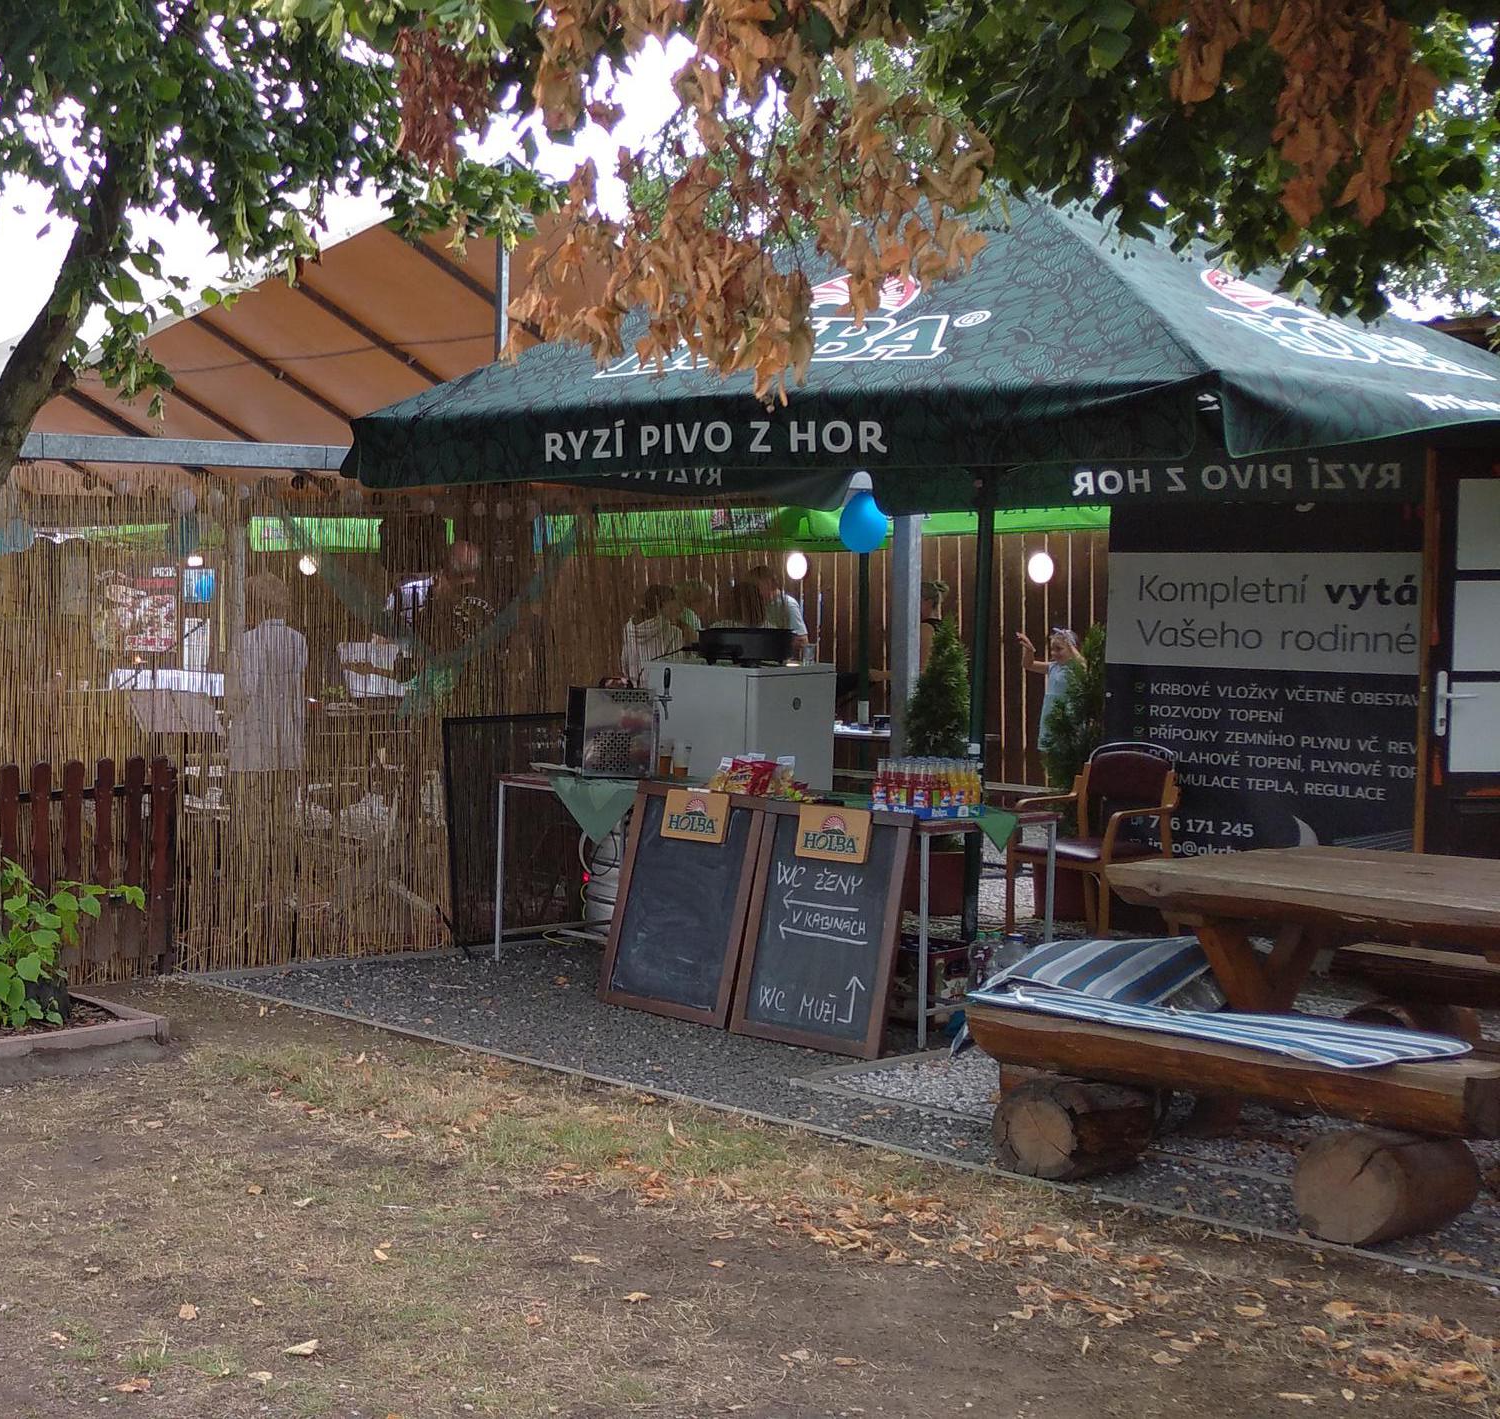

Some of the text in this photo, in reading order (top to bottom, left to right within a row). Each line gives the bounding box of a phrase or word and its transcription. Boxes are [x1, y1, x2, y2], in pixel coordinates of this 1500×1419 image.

[545, 419, 888, 462] RYZÍ PIVO Z HOR
[1139, 574, 1418, 610] Kompletní vytá
[1137, 618, 1416, 654] Vašeho rodinné
[1151, 681, 1211, 697] KRBOVÉ
[1217, 683, 1278, 700] VLOŽKY
[1285, 685, 1346, 703] VČETNĚ
[1150, 705, 1284, 723] ROZVODY TOPENÍ
[1150, 724, 1219, 742] PŘÍPOJKY
[1225, 730, 1295, 747] ZEMNÍHO
[1301, 736, 1350, 751] PLYNU
[1311, 760, 1382, 777] PLYNOVÉ
[1179, 773, 1240, 790] MULACE
[1305, 782, 1386, 801] REGULACE
[668, 814, 716, 833] HOLBA
[1149, 815, 1254, 838] 76 171 245
[803, 832, 857, 853] HOLBA
[777, 862, 863, 895] WC ŽENY
[792, 910, 866, 936] V KABINÁCH
[759, 985, 785, 1011] WC
